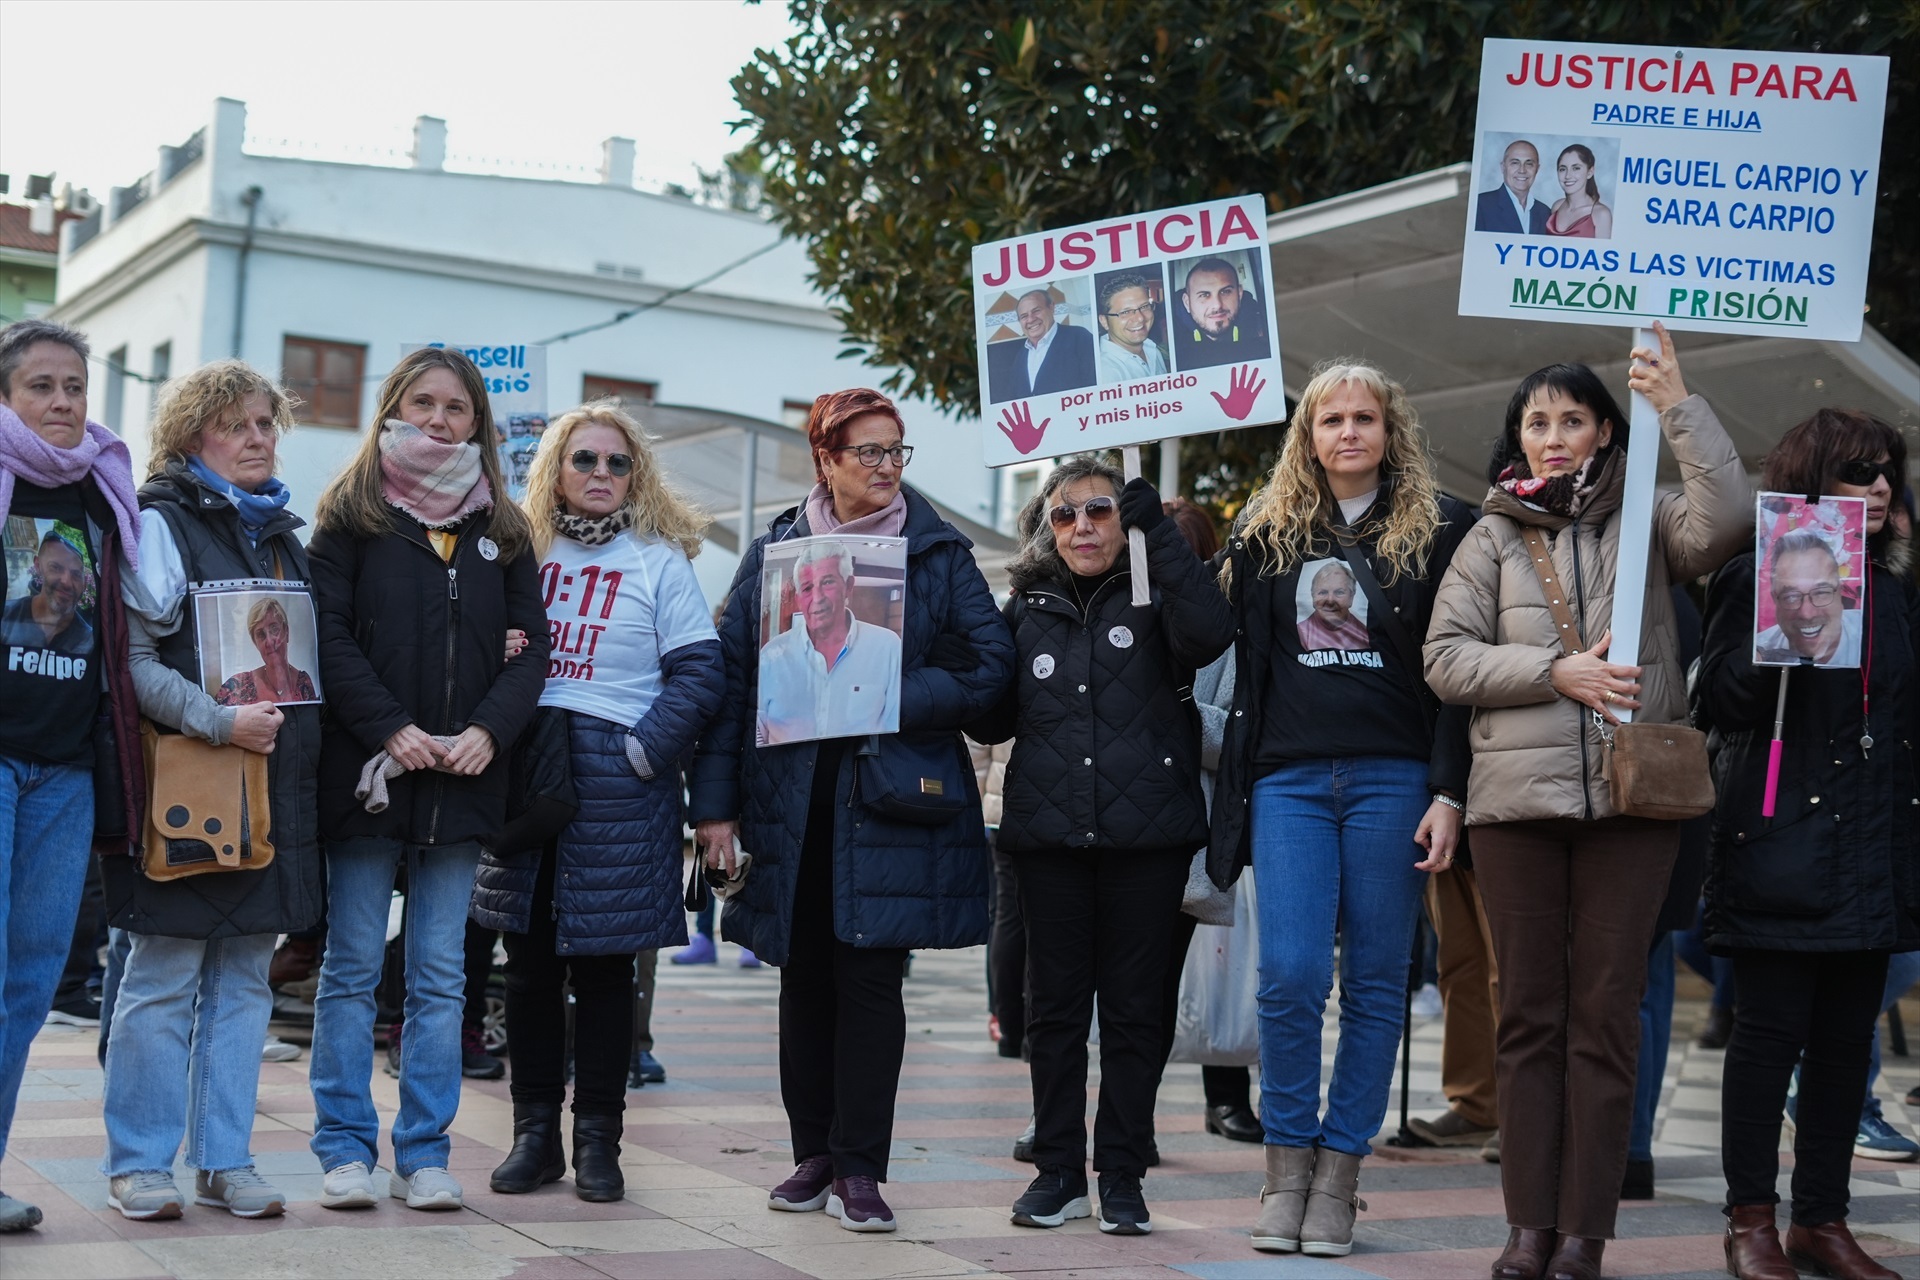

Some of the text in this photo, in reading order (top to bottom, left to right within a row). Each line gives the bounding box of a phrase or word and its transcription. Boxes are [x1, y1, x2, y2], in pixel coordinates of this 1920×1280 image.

[1506, 52, 1858, 102] JUSTICIA PARA
[1593, 103, 1762, 130] PADRE E HIJA
[1622, 157, 1869, 196] MIGUEL CARPIO Y
[1645, 198, 1835, 234] SARA CARPIO
[983, 205, 1259, 287] JUSTICIA
[1494, 243, 1836, 286] Y TODAS LAS VICTIMAS
[1511, 276, 1808, 322] MAZÓN PRISIÓN
[1060, 374, 1198, 411] por mi marido
[1078, 399, 1184, 431] y mis hijos
[8, 646, 87, 680] Felipe
[1297, 650, 1384, 668] MARIA LUISA
